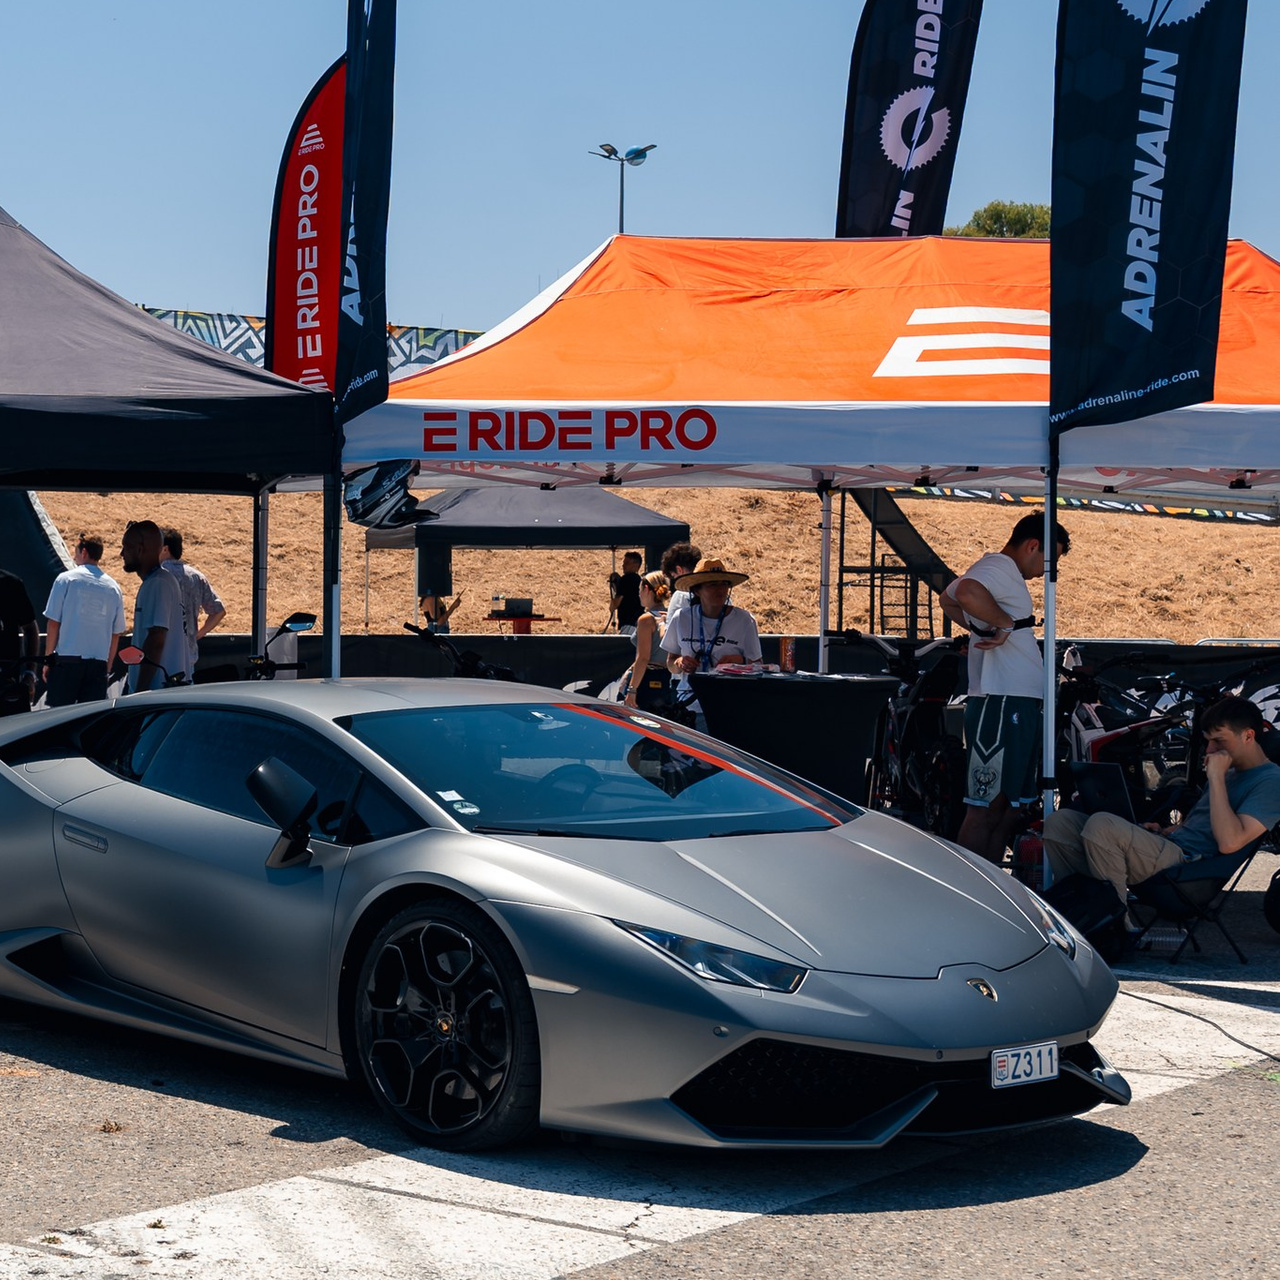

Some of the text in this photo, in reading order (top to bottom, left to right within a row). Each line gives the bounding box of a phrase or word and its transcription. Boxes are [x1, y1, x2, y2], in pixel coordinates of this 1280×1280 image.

[297, 164, 319, 240] PRO
[1120, 47, 1179, 332] ADRENALIN
[297, 246, 320, 329] RIDE
[468, 410, 593, 451] RIDE
[605, 408, 718, 451] PRO
[1010, 1047, 1053, 1080] Z311
